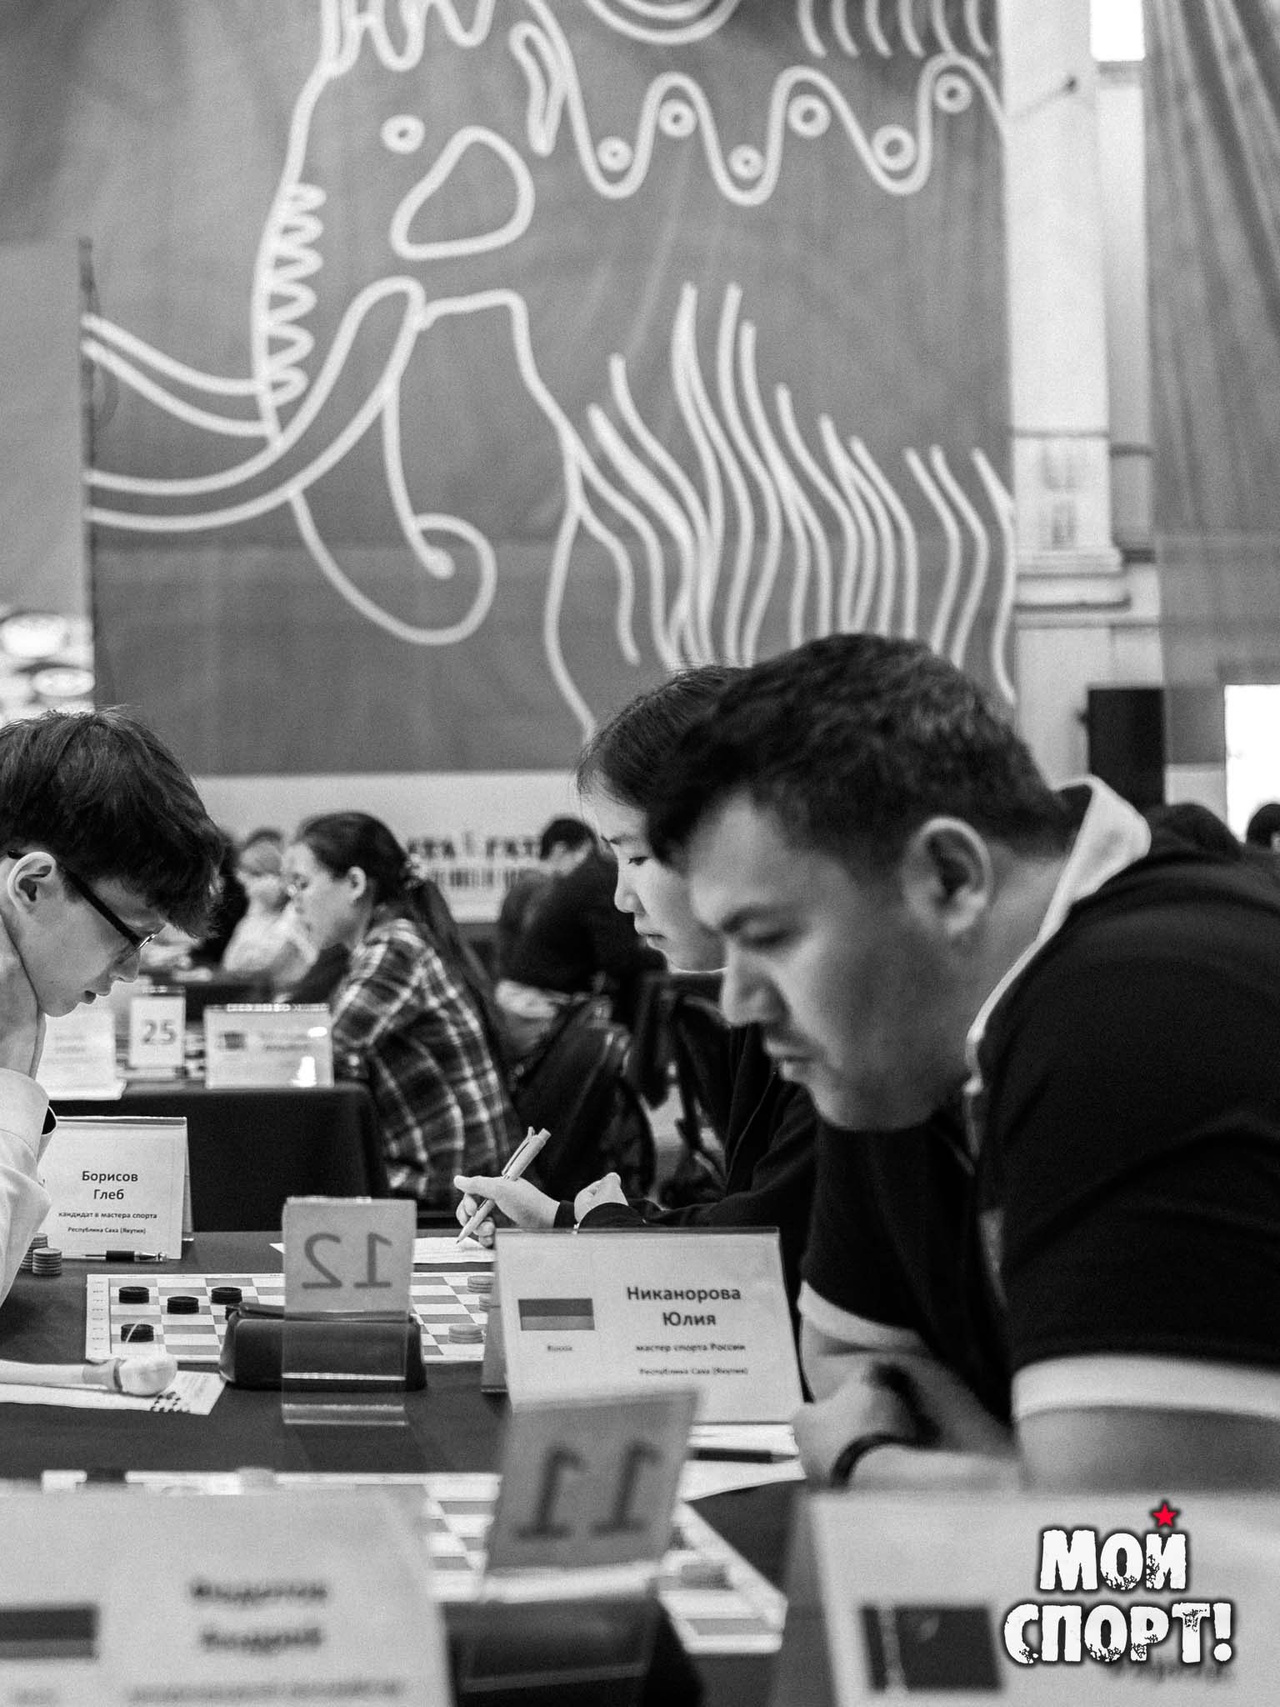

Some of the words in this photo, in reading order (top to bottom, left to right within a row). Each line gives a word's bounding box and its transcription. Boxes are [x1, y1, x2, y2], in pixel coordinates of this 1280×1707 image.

[142, 1019, 177, 1046] 25
[81, 1170, 139, 1184] Борисов
[93, 1188, 125, 1200] Глеб
[58, 1211, 94, 1219] кандидат
[101, 1211, 131, 1220] мастера
[132, 1212, 158, 1220] спорта
[626, 1285, 742, 1304] Никанорова
[662, 1311, 717, 1327] Юлия
[672, 1344, 708, 1353] спорта
